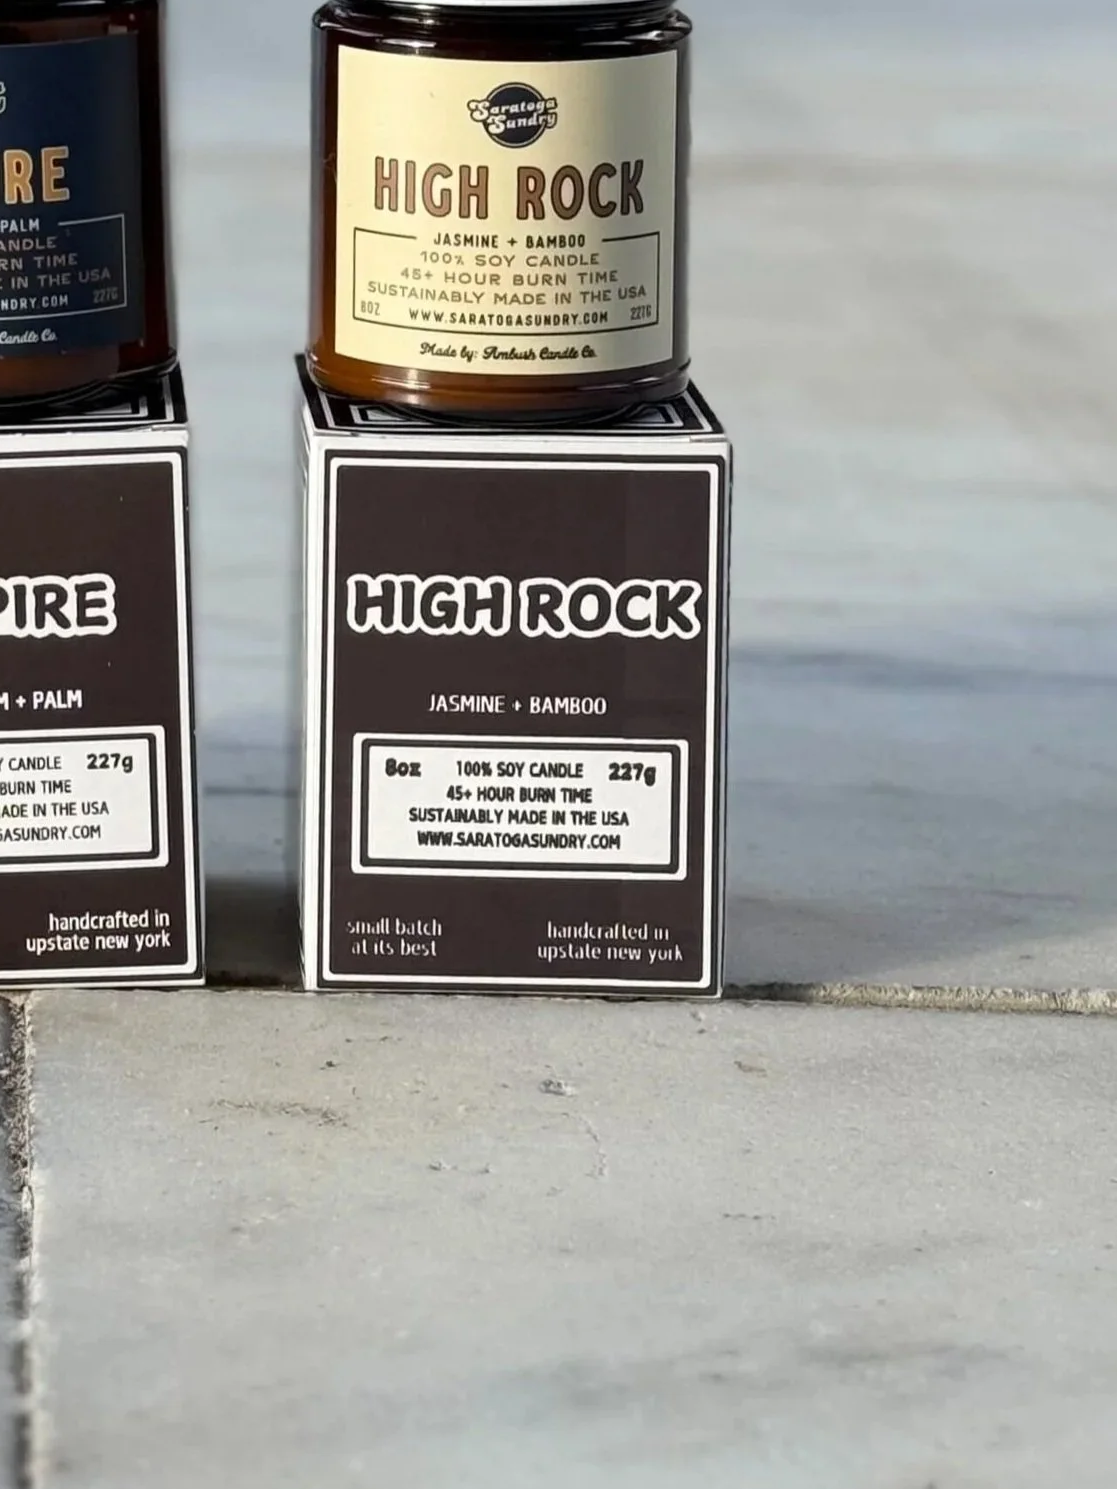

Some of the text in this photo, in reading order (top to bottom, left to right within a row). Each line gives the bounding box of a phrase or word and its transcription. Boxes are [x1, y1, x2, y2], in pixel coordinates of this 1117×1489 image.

[468, 97, 557, 123] Saratoga
[486, 112, 557, 135] Sundry
[374, 156, 644, 220] HIGH ROCK
[0, 219, 40, 233] PALM
[434, 233, 585, 249] JASMINE BAMBOO
[34, 253, 78, 268] TIME
[420, 251, 599, 268] 100% SOY CANDLE
[11, 277, 28, 290] IN
[37, 273, 71, 287] THE
[78, 268, 111, 283] USA
[400, 268, 618, 286] 45+ HOUR BURN TIME
[368, 281, 646, 305] SUSTAINABLY MADE IN THE USA
[420, 342, 456, 358] Made
[482, 346, 536, 360] Ambush
[540, 346, 578, 360] Candle
[350, 576, 699, 636] HIGH ROCK
[33, 690, 82, 709] PALM
[429, 695, 607, 714] JASMINE BAMBOO
[9, 756, 62, 771] CANDLE
[87, 754, 133, 773] 227g
[457, 761, 583, 778] 100% SOY CANDLE
[609, 763, 656, 785] 227g
[0, 781, 35, 795] BURN
[41, 780, 72, 794] TIME
[446, 786, 592, 803] 45+ HOUR BURN TIME
[33, 803, 46, 817] IN
[51, 803, 77, 816] THE
[82, 801, 109, 815] USA
[409, 808, 629, 826] SUSTAINABLY MADE IN THE USA
[418, 830, 620, 849] WWW.SARATOGASUNDRY.COM
[49, 909, 169, 932] handcrafted in
[26, 931, 170, 955] upstate new york
